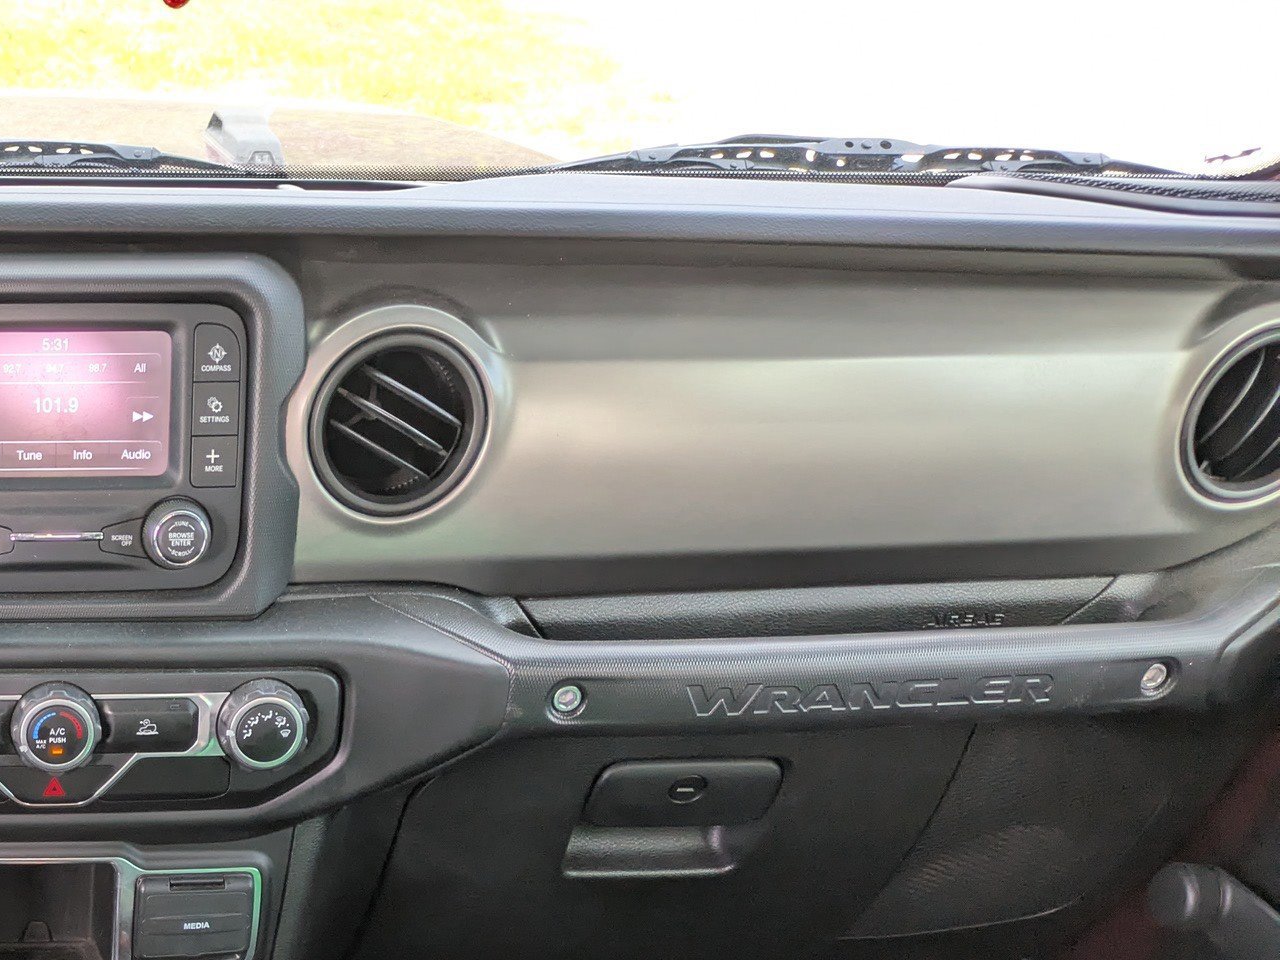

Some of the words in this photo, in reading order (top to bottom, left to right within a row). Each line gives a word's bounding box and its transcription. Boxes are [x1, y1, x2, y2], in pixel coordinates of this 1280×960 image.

[42, 337, 69, 351] 5:31
[134, 362, 147, 373] All
[201, 364, 232, 372] COMPASS
[34, 397, 79, 414] 101.9
[199, 415, 230, 423] SETTINGS
[16, 450, 43, 461] Tune
[73, 450, 93, 460] Info
[121, 449, 151, 460] Audio
[205, 465, 224, 473] MORE
[174, 520, 190, 528] TUNE
[170, 548, 193, 557] SCROLL
[686, 673, 1055, 717] WRANGLER
[49, 727, 65, 736] A/C
[49, 736, 67, 744] PUSH
[183, 921, 210, 930] MEDIA
